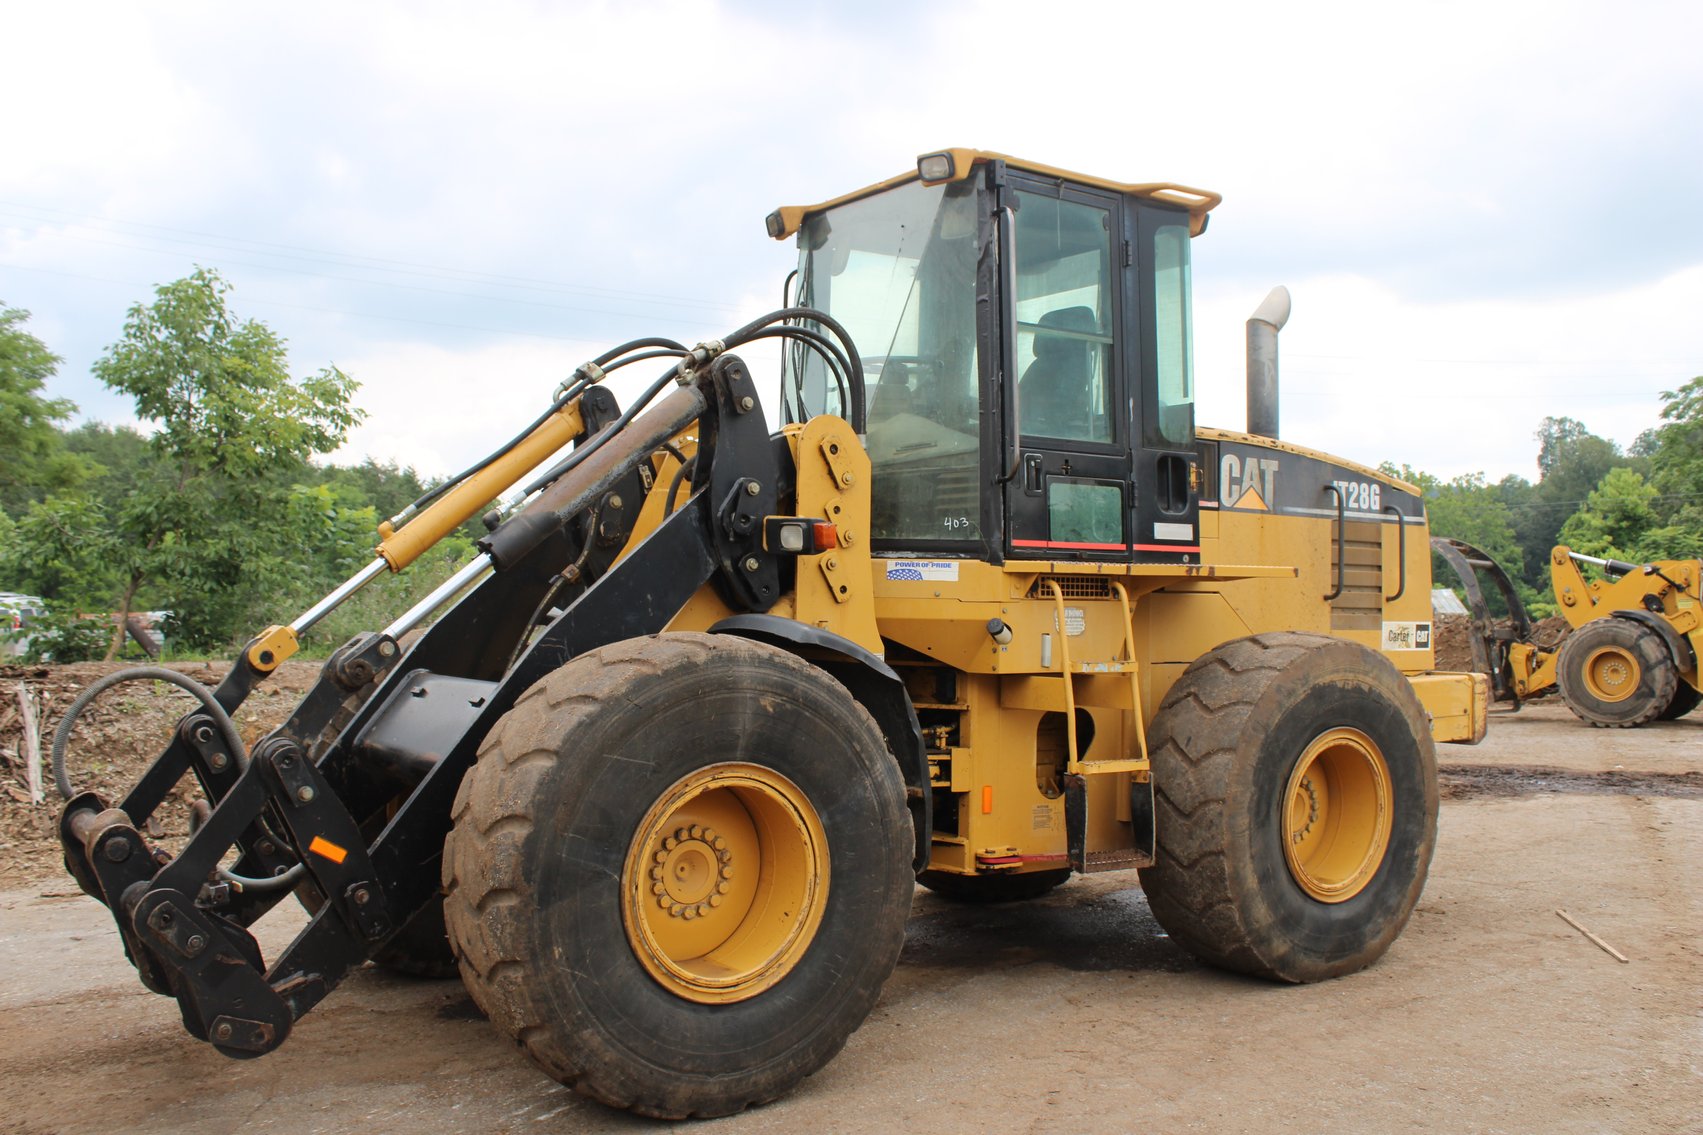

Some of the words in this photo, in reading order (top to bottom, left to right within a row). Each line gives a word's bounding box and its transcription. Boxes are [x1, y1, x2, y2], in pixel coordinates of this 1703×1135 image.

[1220, 454, 1279, 511] CAT
[944, 516, 969, 531] 403
[1388, 629, 1409, 642] Carter
